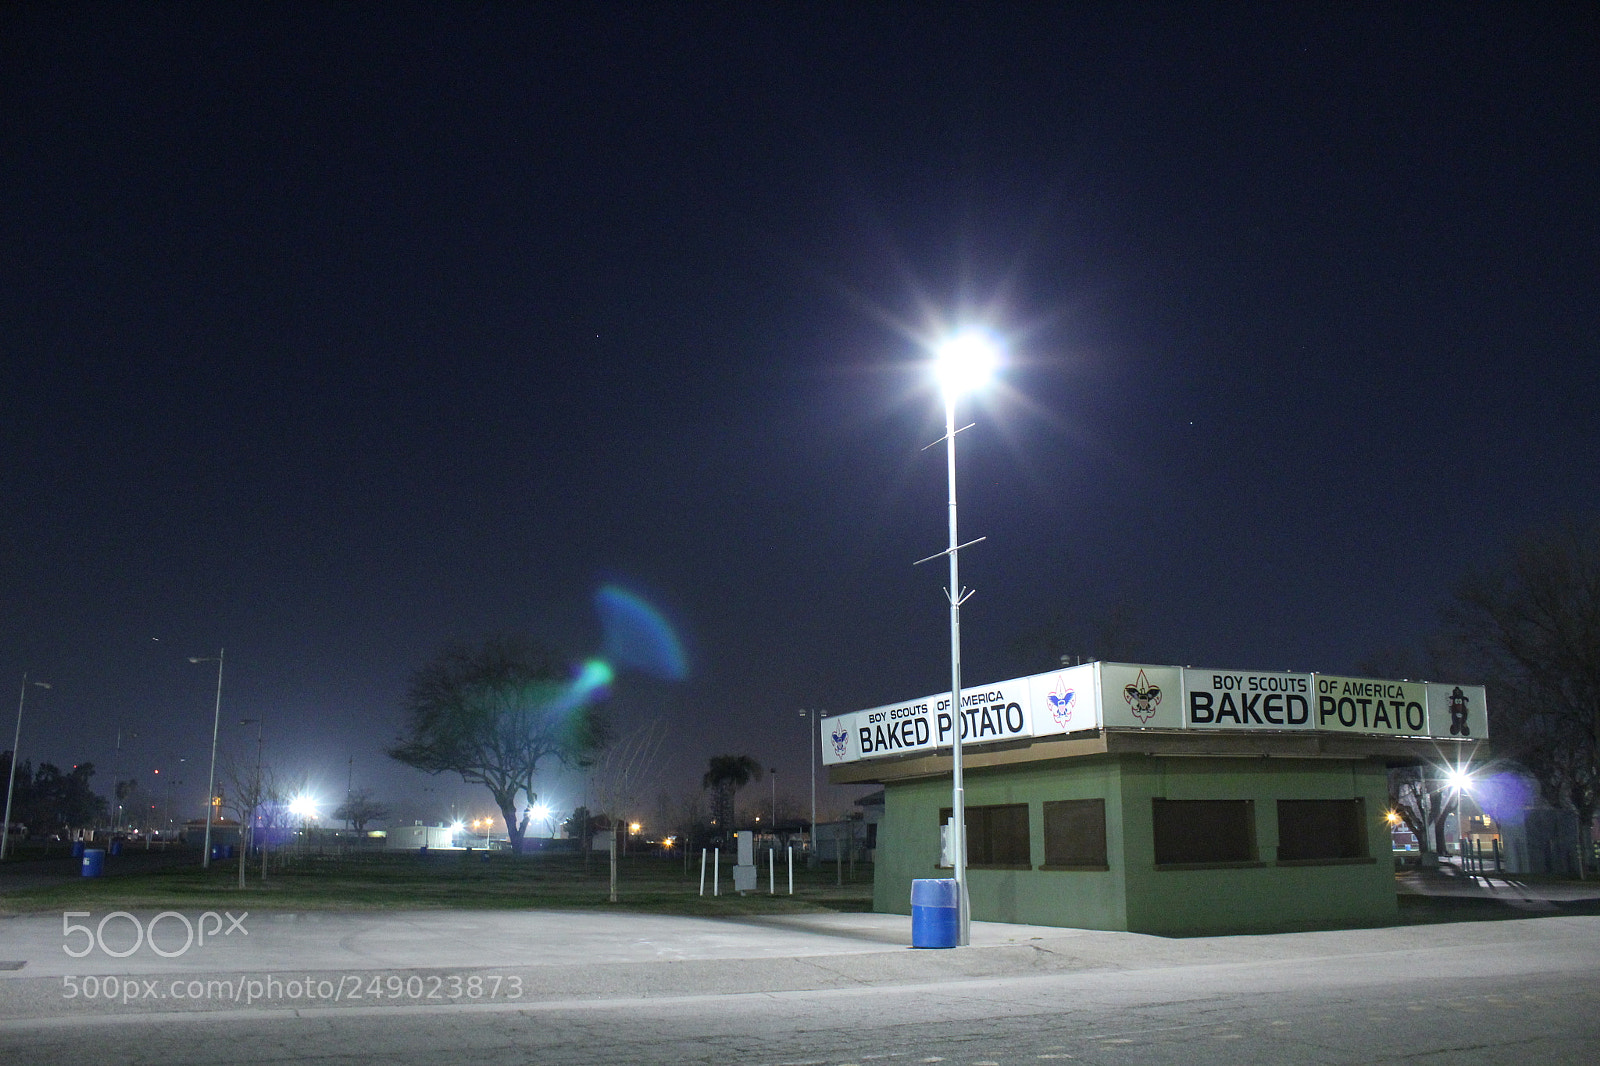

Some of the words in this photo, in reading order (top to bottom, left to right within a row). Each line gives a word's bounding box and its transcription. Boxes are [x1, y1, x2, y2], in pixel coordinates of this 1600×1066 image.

[1213, 675, 1243, 690] BOY
[1248, 676, 1307, 692] SCOUTS
[1318, 680, 1338, 694] OF
[1343, 683, 1405, 699] AMERICA
[869, 712, 887, 724] BOY
[890, 704, 928, 719] SCOUTS
[937, 699, 950, 711] OF
[958, 690, 1004, 707] MERICA
[1190, 691, 1309, 724] BAKED
[1319, 696, 1424, 731] POTATO
[859, 717, 930, 753] BAKED
